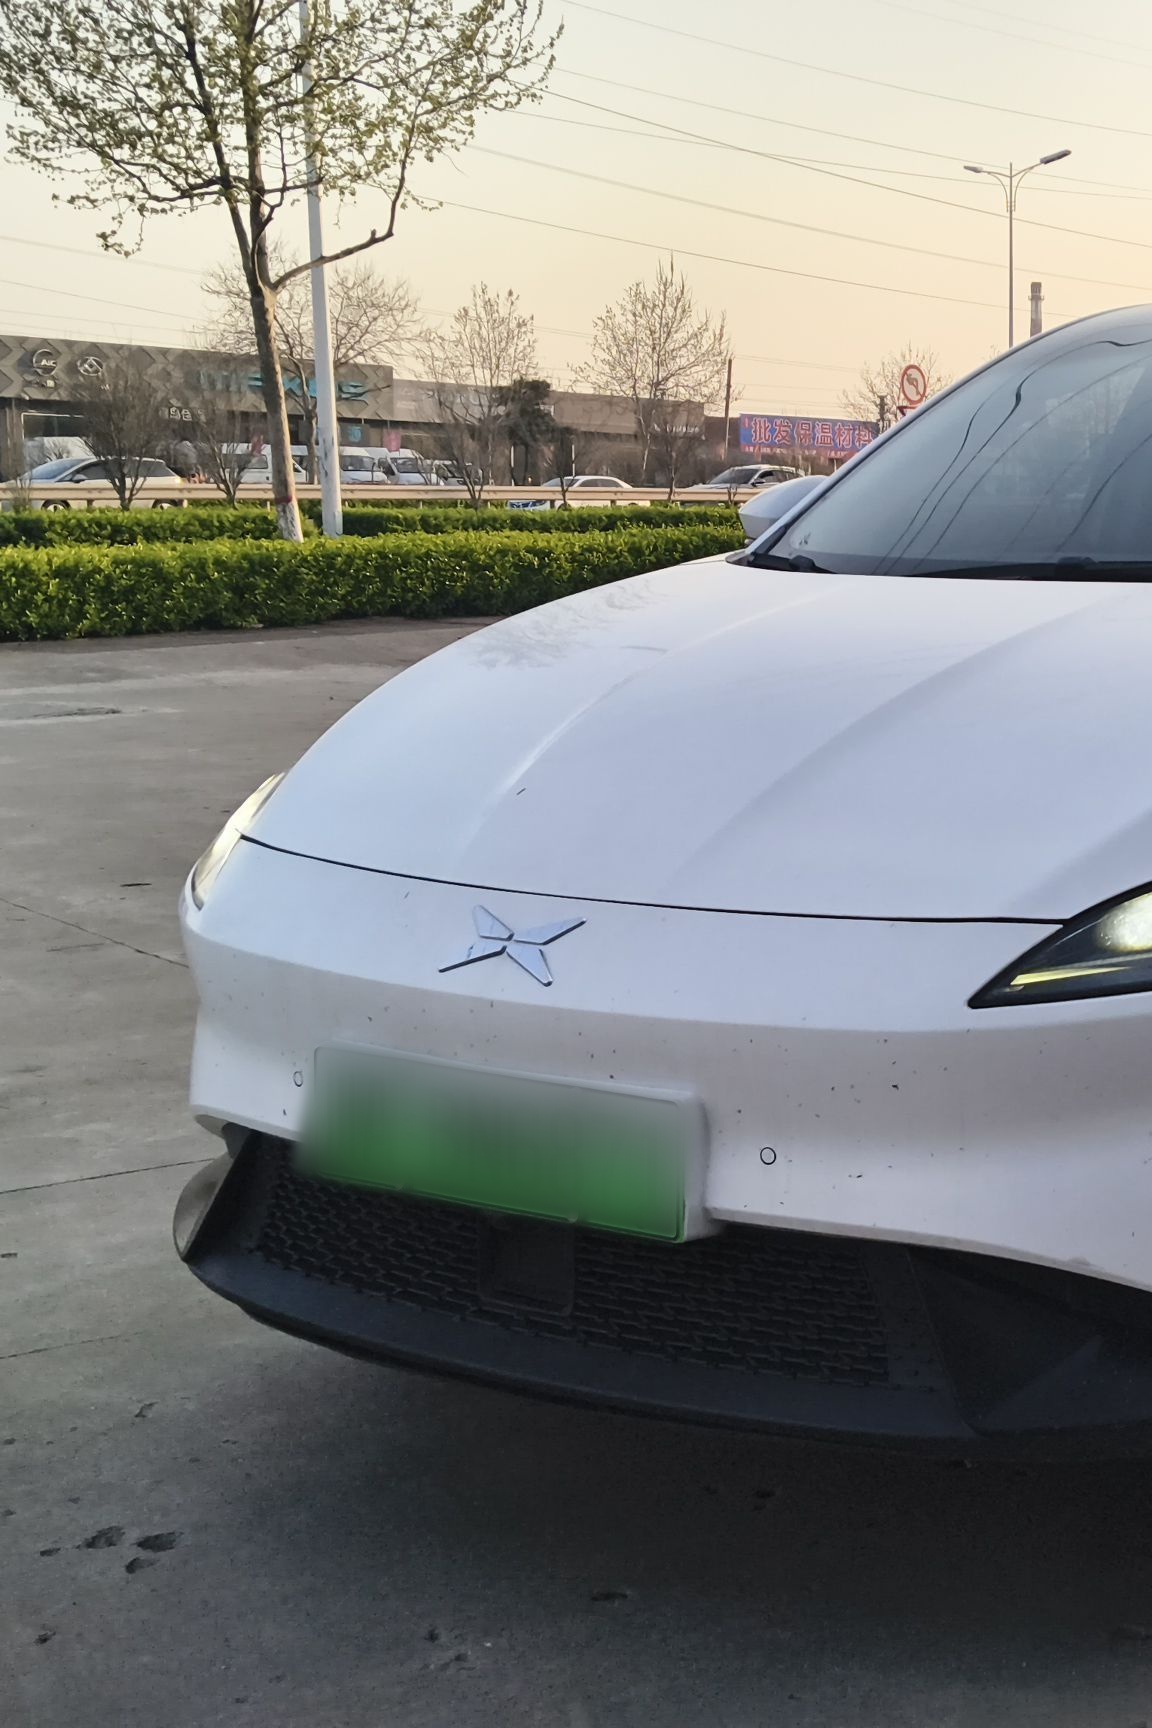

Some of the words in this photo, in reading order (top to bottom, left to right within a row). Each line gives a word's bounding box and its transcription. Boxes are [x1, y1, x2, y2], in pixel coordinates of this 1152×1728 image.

[751, 416, 874, 448] 批发保温材料
